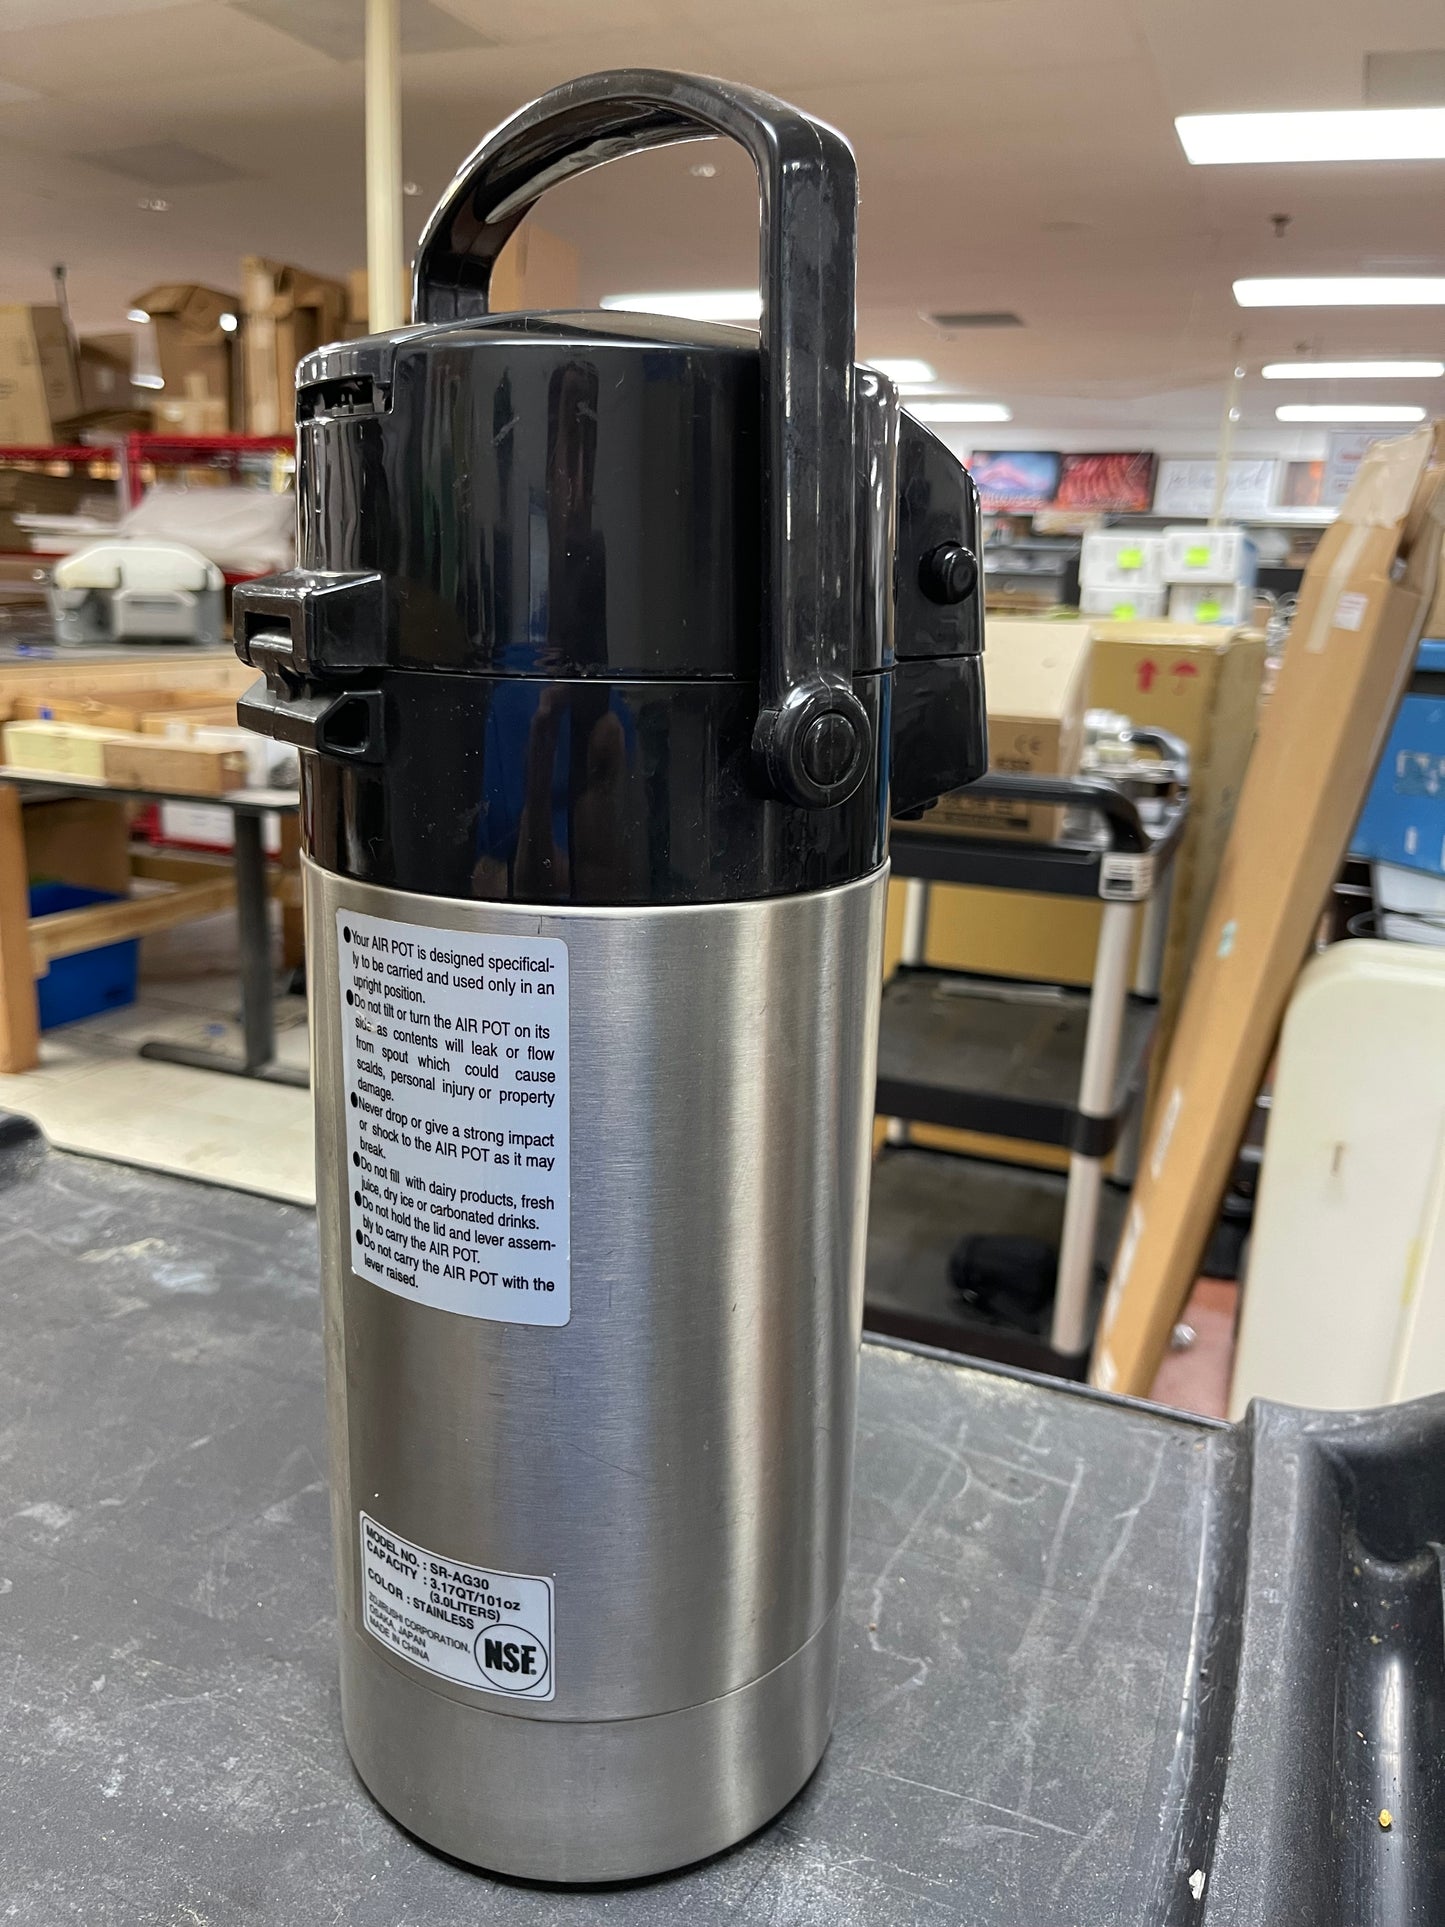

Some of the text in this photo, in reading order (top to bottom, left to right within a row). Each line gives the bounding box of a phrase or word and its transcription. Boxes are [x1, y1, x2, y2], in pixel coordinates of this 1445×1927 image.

[352, 929, 555, 972] Your AIR POT is designed specifical-
[353, 951, 555, 996] ly to be carried and used only in an
[354, 976, 425, 1003] upright position.
[355, 995, 550, 1039] Do not tilt or turn the AIR POT on its
[356, 1036, 556, 1082] from spout which could cause
[377, 1024, 387, 1037] as
[393, 1029, 438, 1048] contents
[445, 1039, 464, 1053] will
[471, 1041, 498, 1056] leak
[506, 1047, 519, 1059] or
[528, 1046, 555, 1060] flow
[357, 1057, 555, 1107] scalds, personal injury or property
[358, 1077, 394, 1101] damage.
[359, 1097, 555, 1149] Never drop or give a strong impact
[359, 1119, 555, 1171] or shock to the AIR POT as it may
[360, 1137, 386, 1159] break.
[361, 1156, 555, 1209] Do not fill with dairy products, fresh
[361, 1175, 539, 1229] juice, dry ice or carbonated drinks.
[363, 1195, 556, 1251] Do not hold the lid and lever assem-
[363, 1215, 480, 1263] bly to carry the AIR POT.
[364, 1233, 555, 1291] Do not carry the AIR POT with the
[365, 1253, 418, 1288] lever raised.
[366, 1525, 400, 1557] MODEL
[401, 1550, 420, 1567] NO.
[430, 1563, 489, 1590] SR-AG30
[367, 1540, 417, 1579] CAPACITY
[430, 1578, 521, 1610] 3.17QT/101oz
[368, 1568, 403, 1600] COLOR
[413, 1597, 474, 1629] STAINLESS
[430, 1591, 500, 1622] (3.0LITERS)
[370, 1615, 430, 1662] MADE IN CHINA
[398, 1626, 426, 1647] JAPAN
[485, 1639, 536, 1674] NSF
